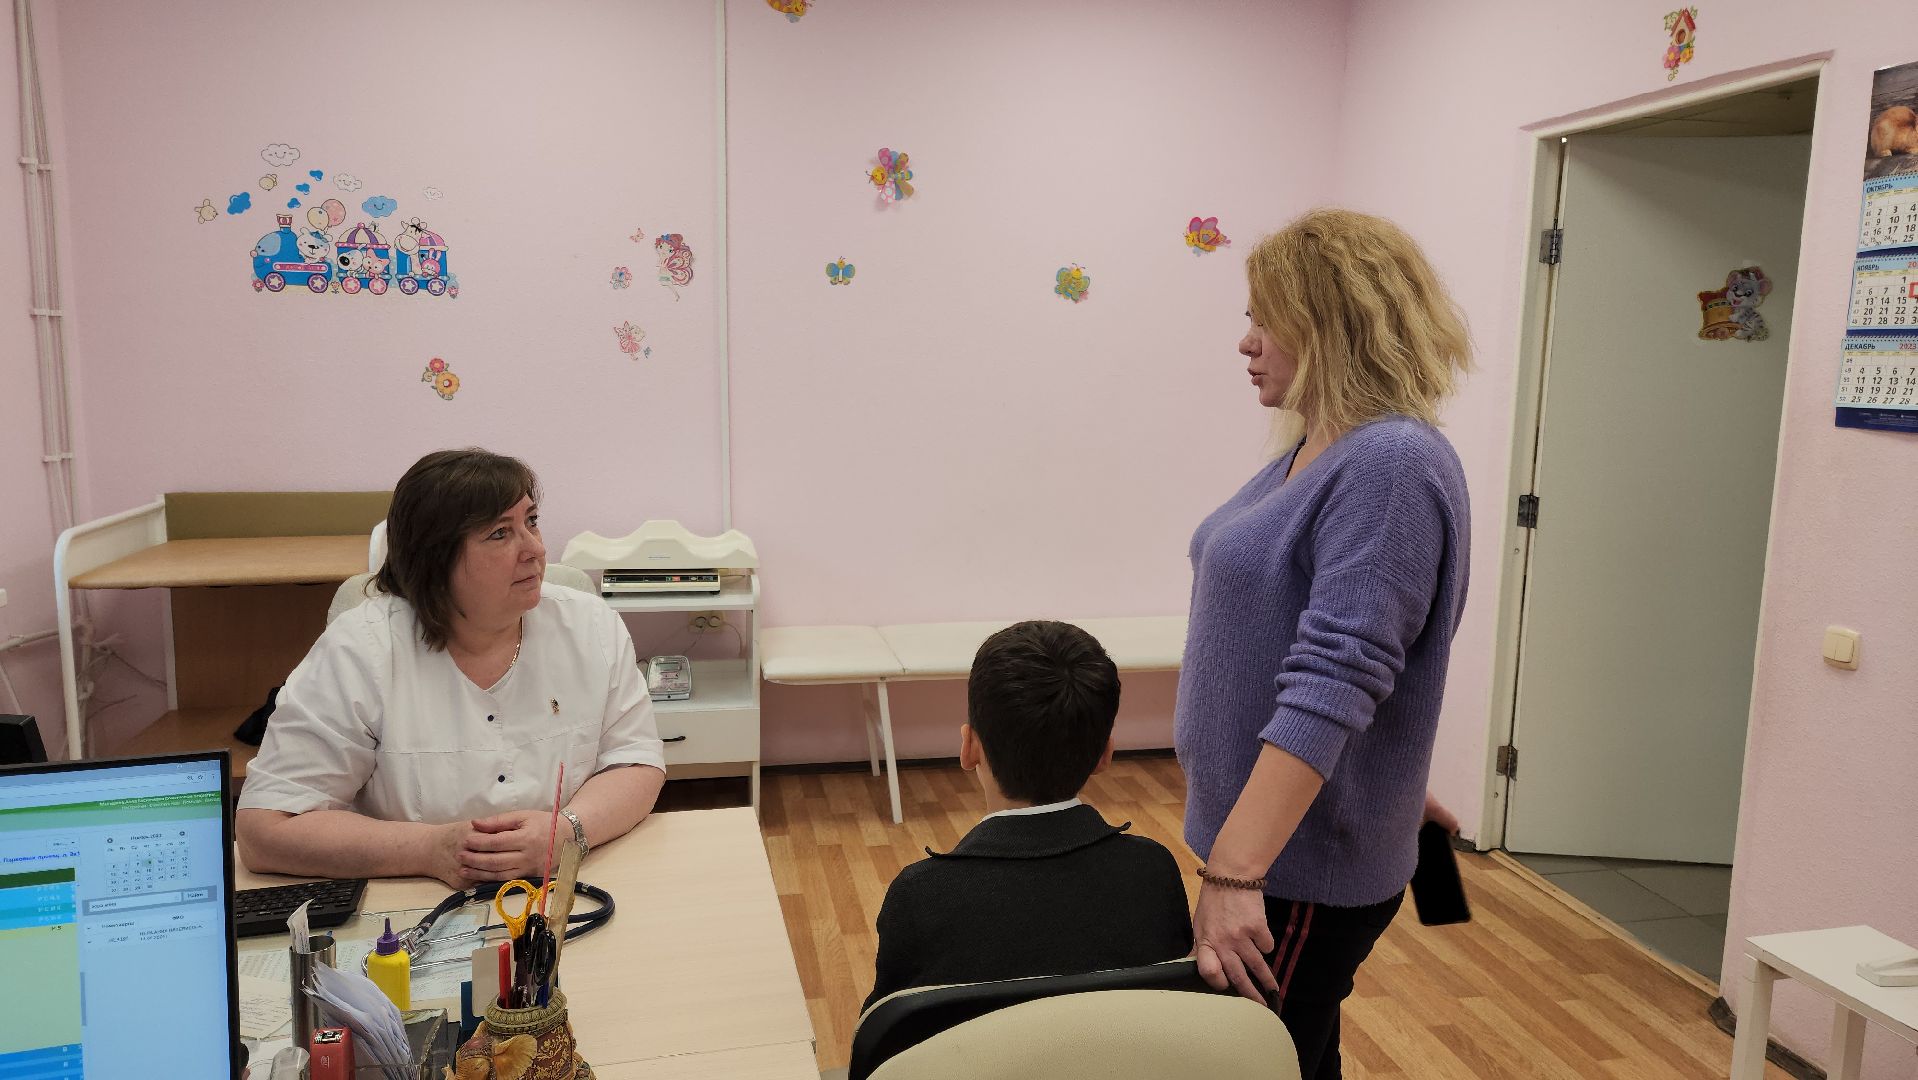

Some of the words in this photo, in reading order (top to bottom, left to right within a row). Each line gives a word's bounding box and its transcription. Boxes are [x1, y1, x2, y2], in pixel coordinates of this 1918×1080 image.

[1866, 184, 1893, 193] ОКТЯБРЬ
[1907, 214, 1917, 222] 11
[1888, 226, 1898, 234] 17
[1906, 224, 1916, 232] 18
